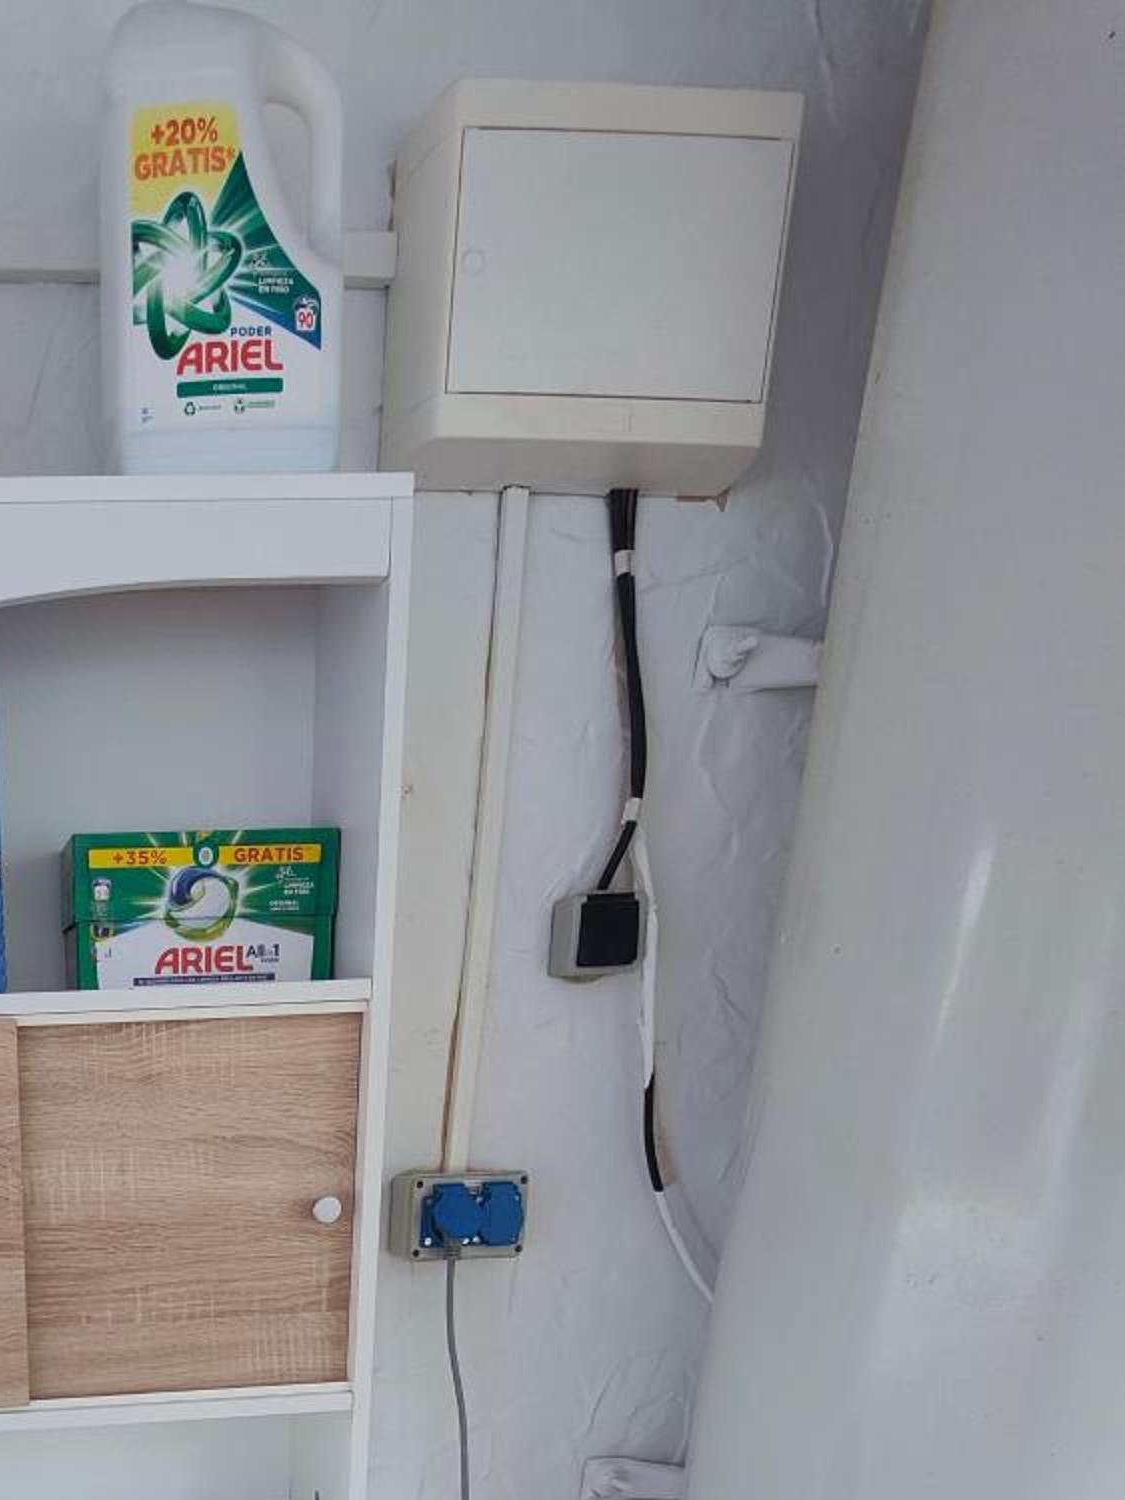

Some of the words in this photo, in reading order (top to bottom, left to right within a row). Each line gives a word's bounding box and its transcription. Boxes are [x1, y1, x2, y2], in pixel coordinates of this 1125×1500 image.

[150, 116, 218, 146] +20%
[298, 311, 314, 328] 90
[230, 326, 272, 337] PODER
[177, 341, 283, 375] ARIEL
[113, 850, 167, 865] +35%
[234, 847, 303, 863] GRATIS
[154, 945, 253, 974] ARIEL
